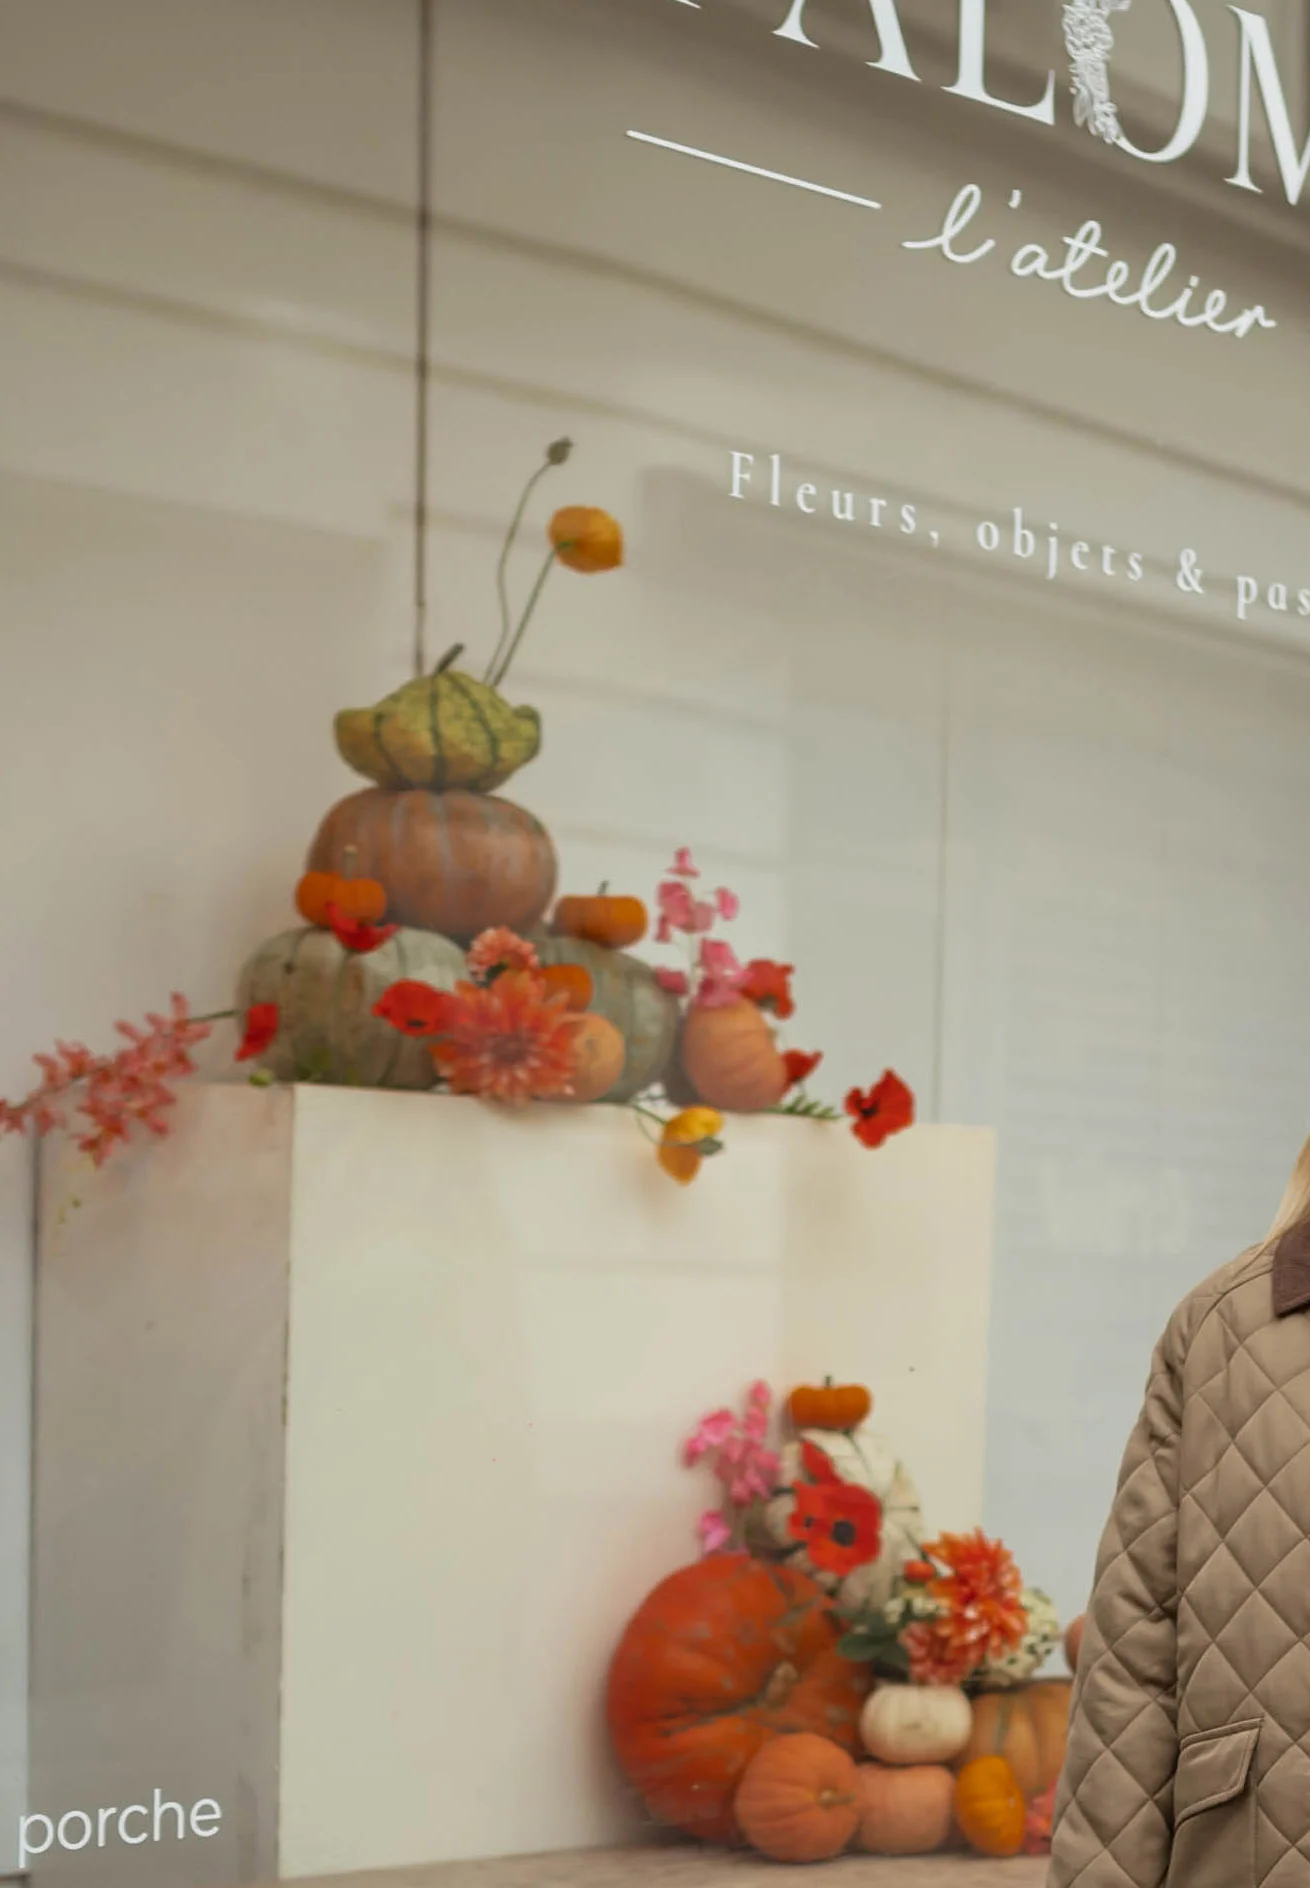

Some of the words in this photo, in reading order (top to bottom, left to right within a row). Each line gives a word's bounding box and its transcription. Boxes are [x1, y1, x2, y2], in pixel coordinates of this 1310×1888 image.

[902, 184, 1277, 338] l'atelier
[729, 451, 941, 547] Fleurs,
[976, 508, 1145, 581] objets
[1175, 548, 1204, 593] &
[18, 1788, 222, 1869] porche
